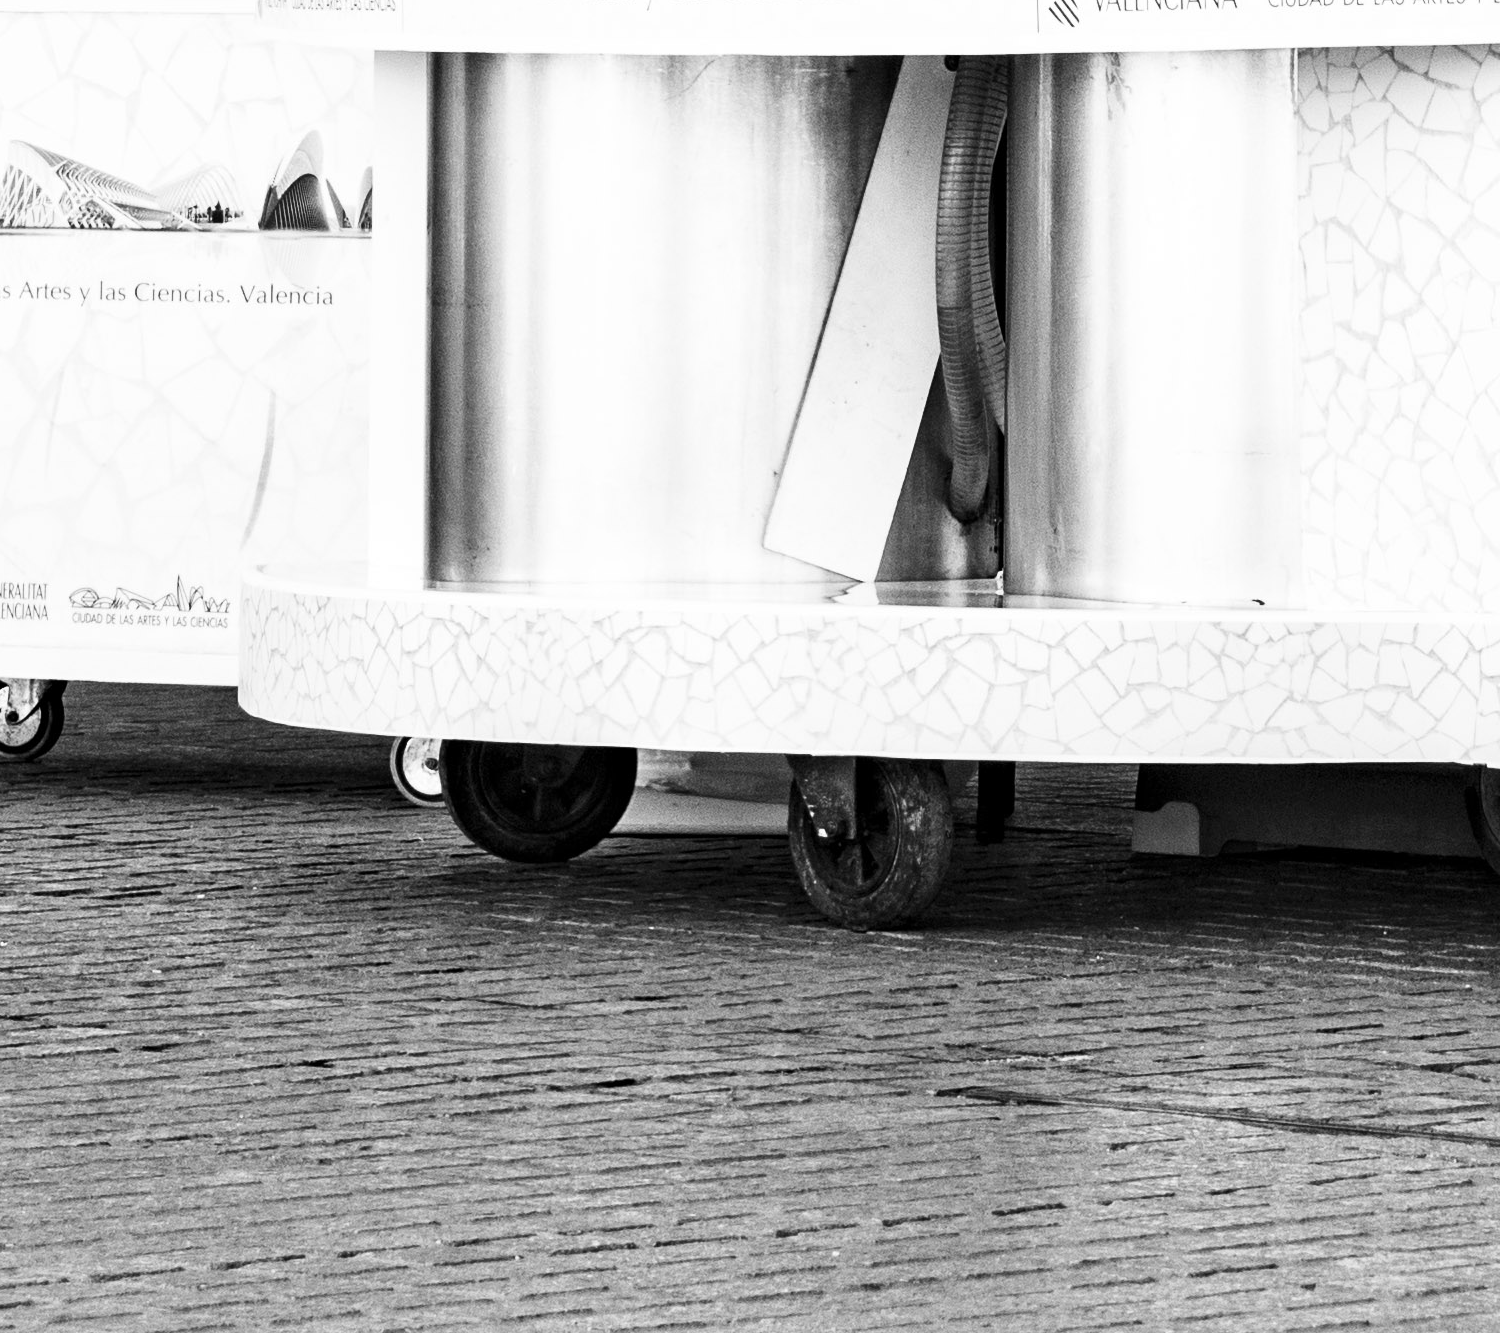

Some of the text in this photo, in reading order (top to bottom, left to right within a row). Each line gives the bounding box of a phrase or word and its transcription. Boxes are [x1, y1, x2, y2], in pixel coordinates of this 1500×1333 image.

[18, 281, 71, 302] Artes
[78, 286, 90, 307] y
[100, 280, 126, 302] las
[133, 281, 231, 305] Ciencias.
[240, 283, 334, 306] Valencia
[72, 612, 104, 625] CIUDAD
[106, 613, 116, 625] DE
[119, 613, 134, 626] LAS
[137, 614, 161, 627] ARTES
[173, 615, 187, 627] LAS
[190, 616, 229, 629] CIENCIAS
